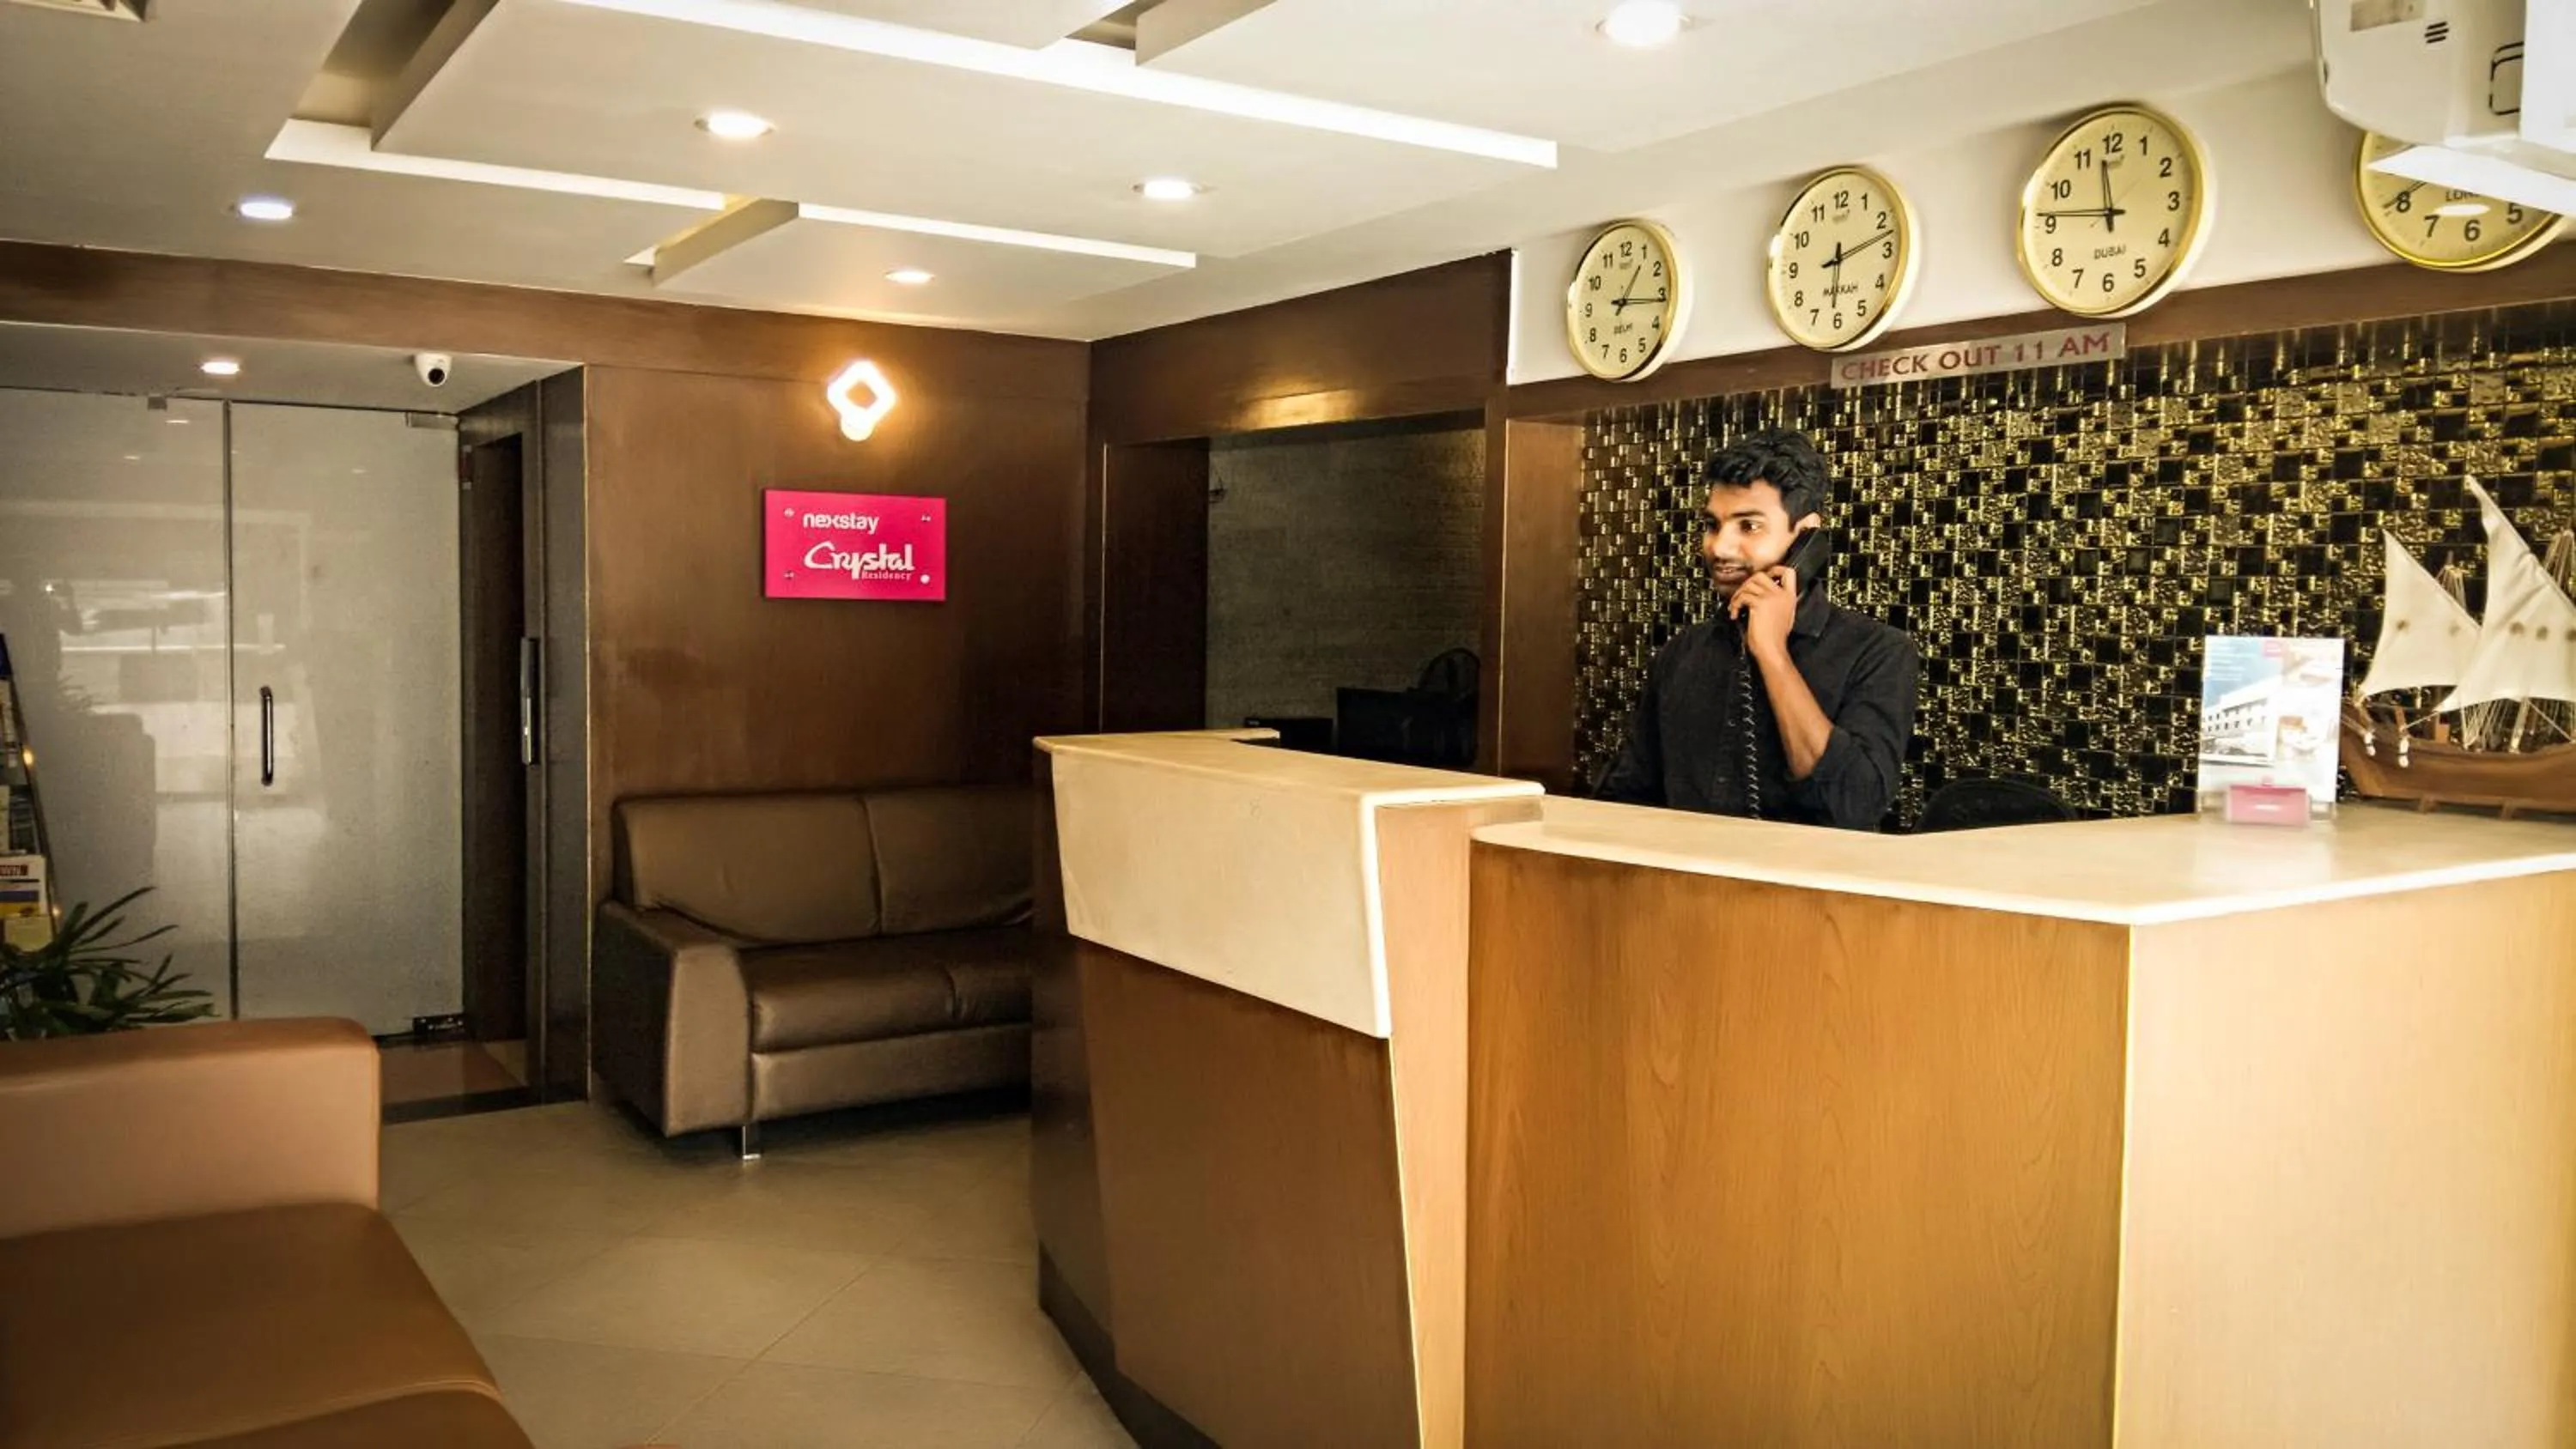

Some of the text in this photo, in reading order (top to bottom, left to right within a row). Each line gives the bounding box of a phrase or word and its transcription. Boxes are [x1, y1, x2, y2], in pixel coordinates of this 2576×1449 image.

[2102, 132, 2123, 155] 12
[2139, 136, 2148, 155] 1
[2074, 149, 2092, 170] 11
[2160, 157, 2172, 178] 2
[2050, 179, 2071, 201] 10
[1833, 190, 1849, 209] 12
[1861, 192, 1868, 210] 1
[2167, 191, 2180, 211] 3
[2396, 191, 2410, 213] 8
[1811, 204, 1825, 222] 11
[1876, 211, 1886, 229] 2
[2506, 202, 2523, 224] 5
[2044, 215, 2057, 234] 9
[2424, 215, 2440, 239] 7
[2464, 220, 2481, 242] 6
[1794, 231, 1809, 250] 10
[2158, 228, 2170, 247] 4
[1620, 241, 1631, 258] 12
[1641, 244, 1648, 259] 1
[1882, 241, 1893, 258] 3
[2051, 248, 2063, 267] 8
[2093, 245, 2127, 259] DUBAI
[1602, 253, 1613, 268] 11
[1653, 261, 1662, 276] 2
[2134, 258, 2146, 278] 5
[1789, 262, 1798, 279] 9
[2072, 269, 2084, 289] 7
[1589, 276, 1601, 291] 10
[1875, 273, 1885, 289] 4
[2102, 273, 2114, 292] 6
[1658, 288, 1667, 302] 3
[1794, 290, 1803, 306] 8
[1585, 303, 1592, 318] 9
[1809, 308, 1819, 325] 7
[1856, 300, 1867, 317] 5
[1652, 315, 1660, 330] 4
[1833, 312, 1842, 330] 6
[1589, 328, 1596, 343] 8
[1602, 344, 1609, 360] 7
[1638, 337, 1646, 353] 5
[1619, 348, 1627, 363] 6
[1841, 332, 2111, 380] CHECK OUT 11 AM
[803, 512, 879, 534] nexstay
[804, 541, 914, 580] Crystal
[861, 571, 911, 580] Residency
